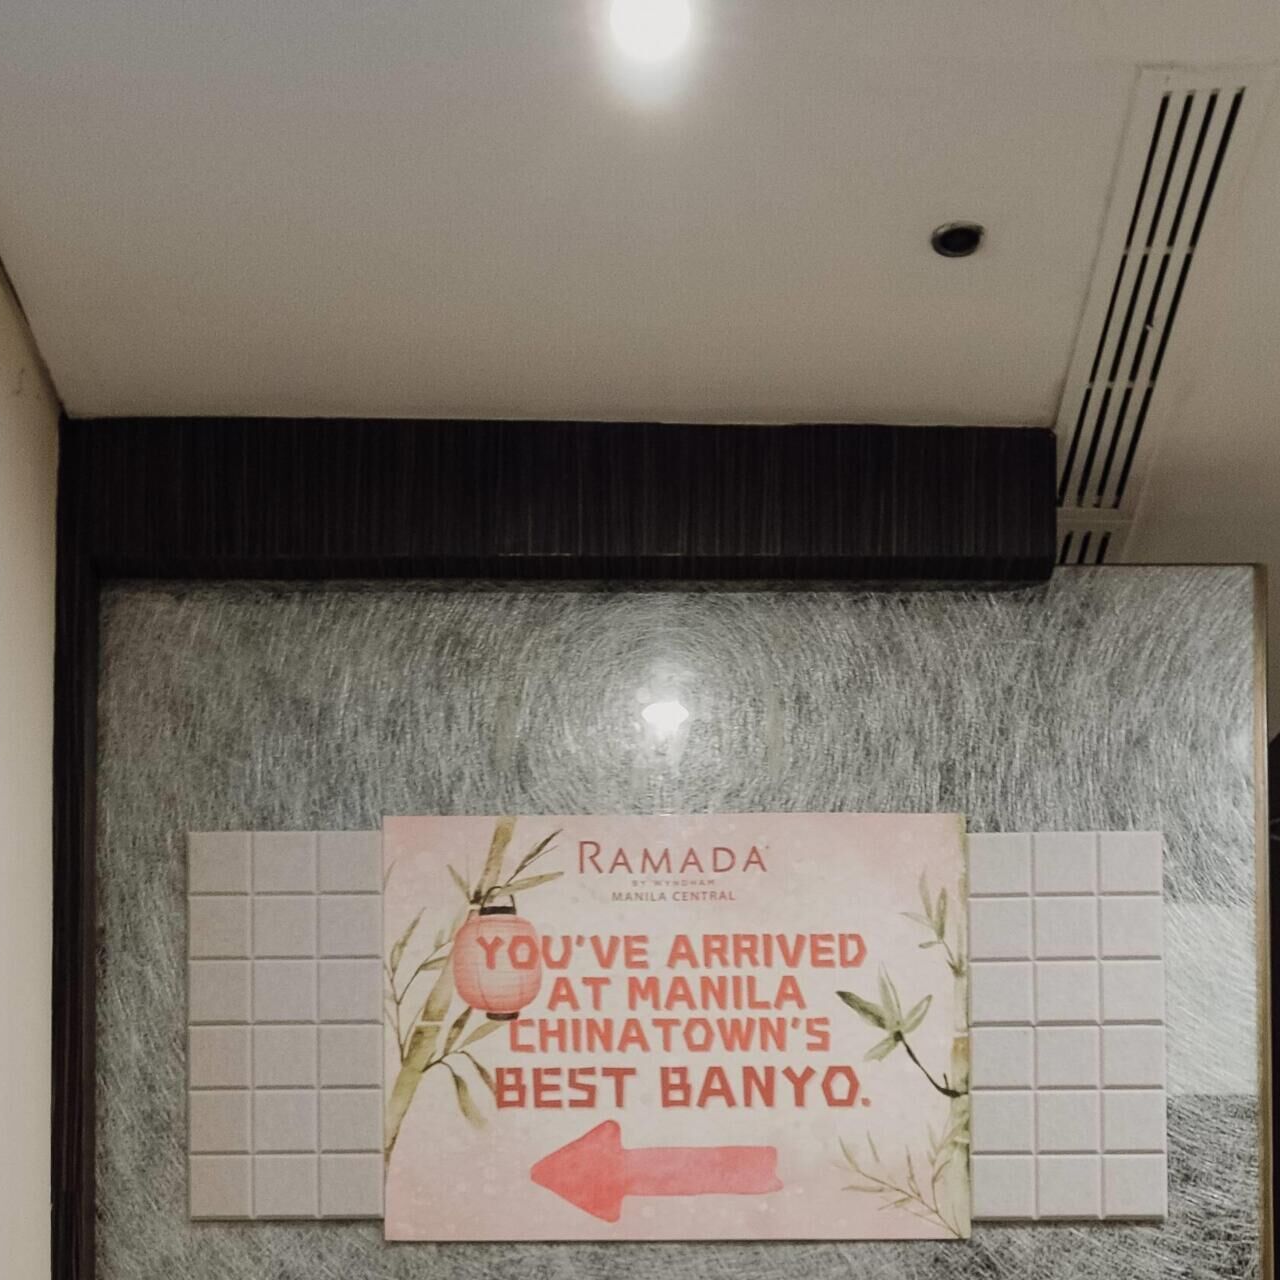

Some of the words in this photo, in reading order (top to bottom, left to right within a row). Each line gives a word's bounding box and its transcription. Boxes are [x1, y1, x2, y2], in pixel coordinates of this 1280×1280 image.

[579, 840, 770, 874] RAMADA
[611, 892, 667, 902] MANILA
[671, 891, 736, 902] CENTRAL
[476, 934, 650, 970] YOU'VE
[666, 933, 867, 969] ARRIVED
[547, 976, 612, 1011] AT
[627, 975, 807, 1011] MANILA
[509, 1017, 831, 1053] CHINATOWN'S
[495, 1067, 637, 1108] BEST
[660, 1065, 872, 1108] BANYO.
